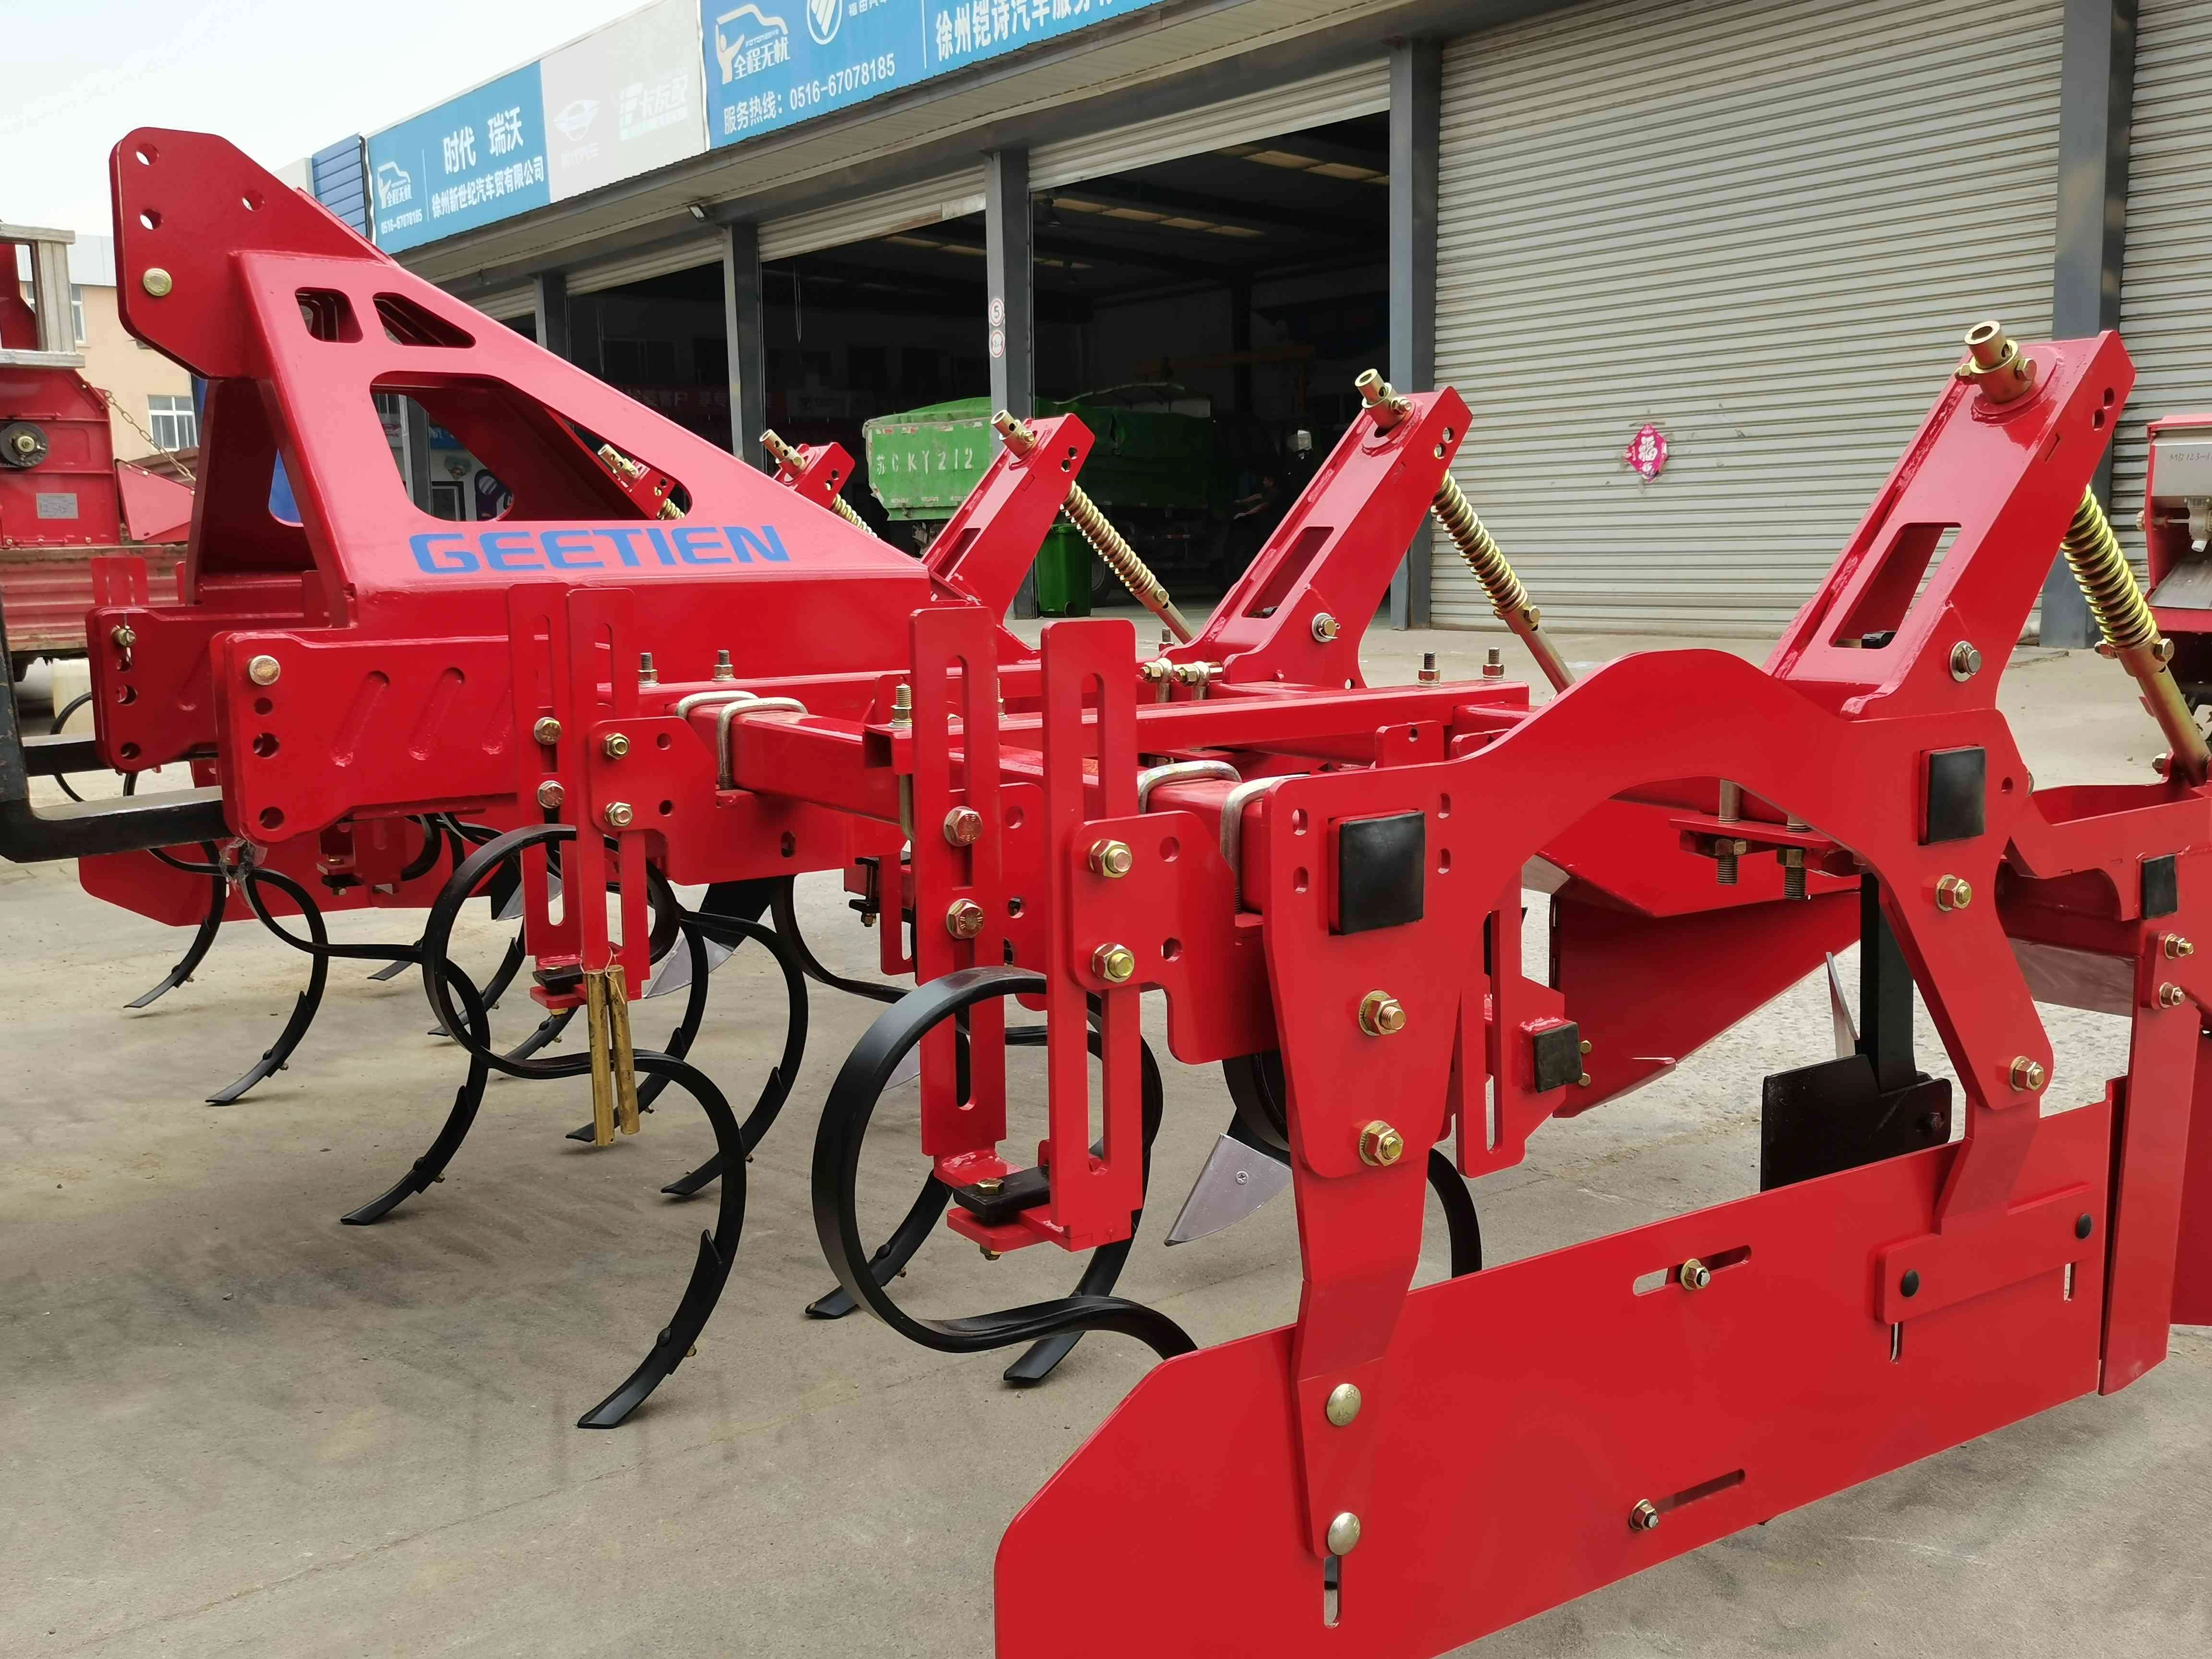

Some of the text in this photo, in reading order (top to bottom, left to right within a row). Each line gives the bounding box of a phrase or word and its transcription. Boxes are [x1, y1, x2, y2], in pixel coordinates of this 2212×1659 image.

[848, 0, 888, 17] 福田汽
[936, 0, 1112, 61] 徐州铠诗汽车服
[734, 37, 790, 80] 全程无忧
[790, 53, 895, 110] 0516-67078185
[443, 107, 524, 175] 时代 瑞沃
[432, 156, 544, 219] 徐州新世纪汽车贸有限公司
[994, 305, 1000, 319] 5
[409, 525, 791, 575] GEETIEN
